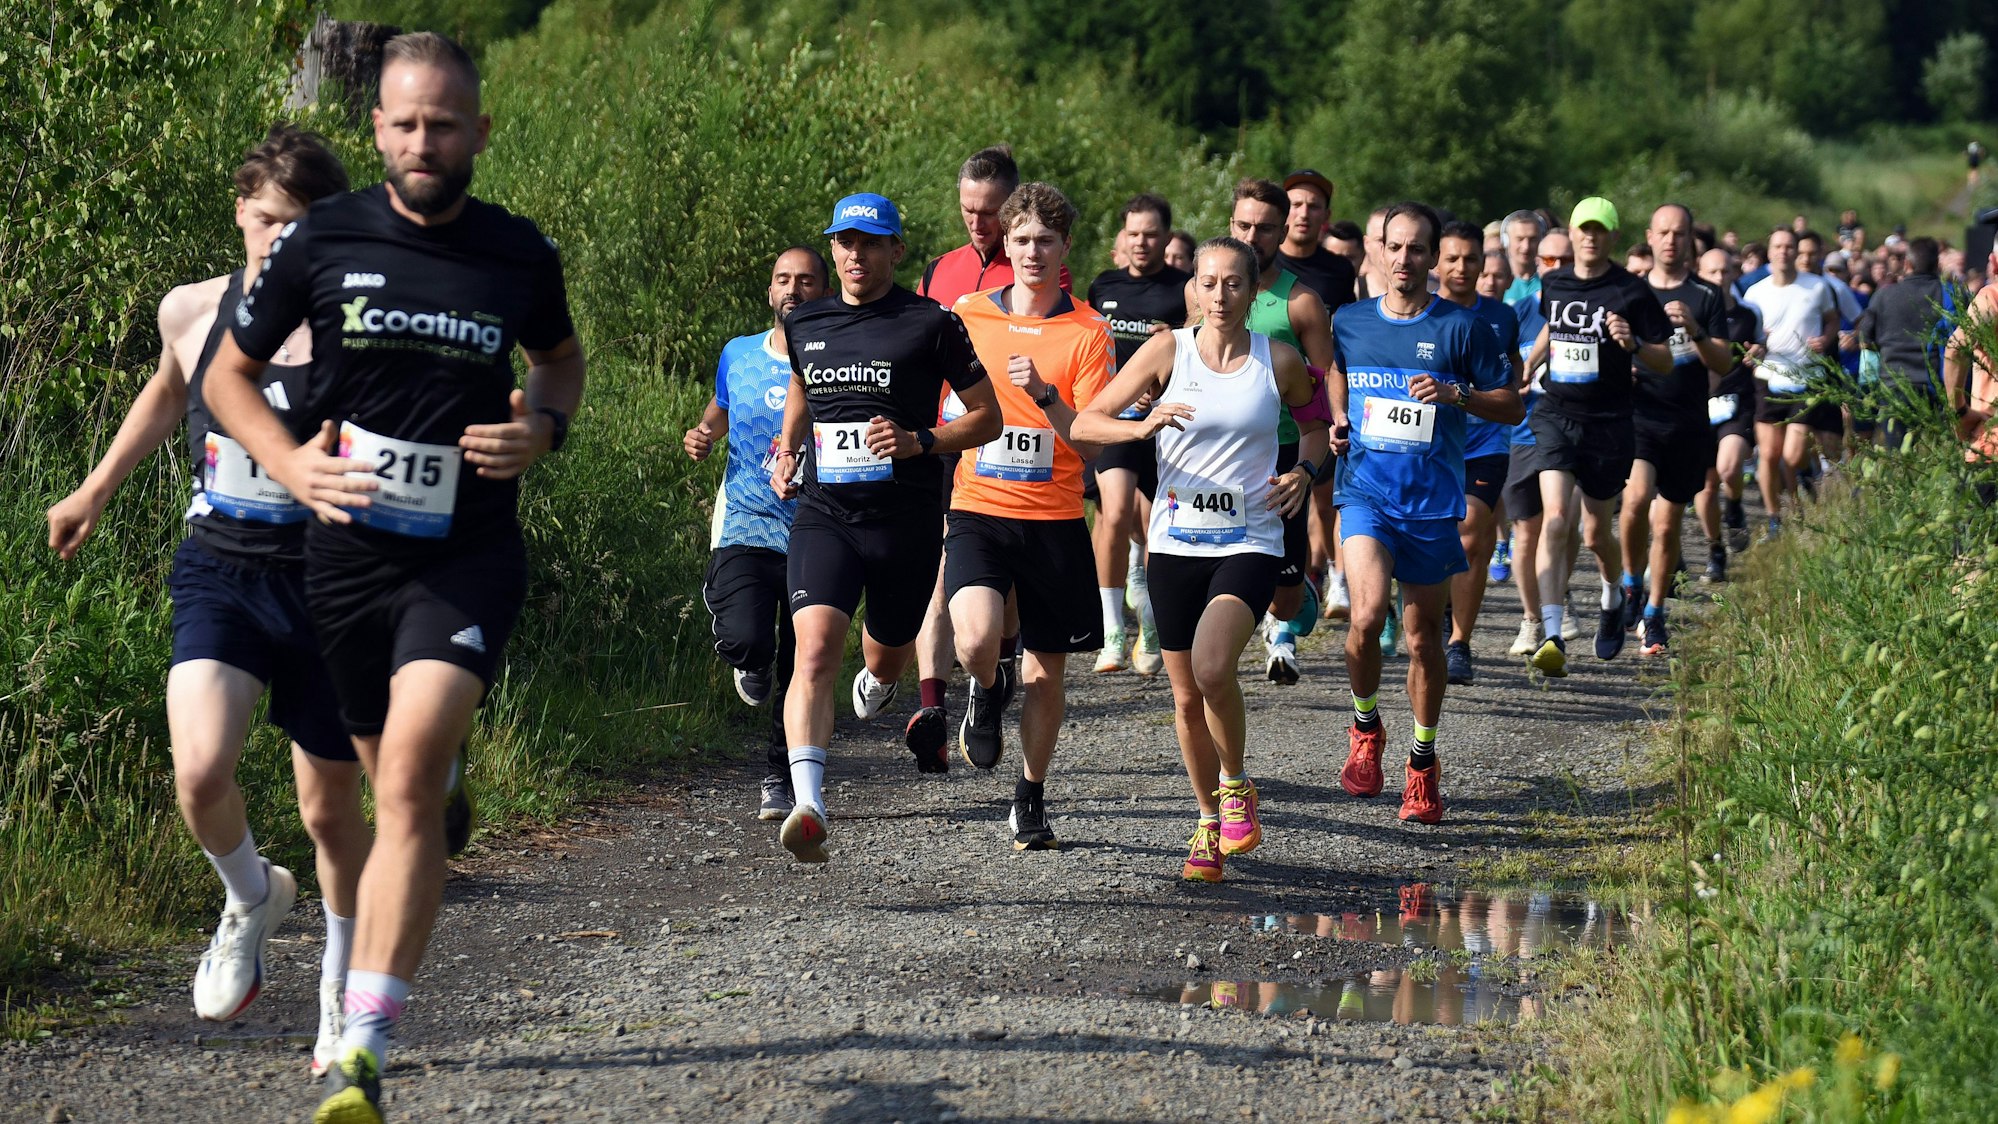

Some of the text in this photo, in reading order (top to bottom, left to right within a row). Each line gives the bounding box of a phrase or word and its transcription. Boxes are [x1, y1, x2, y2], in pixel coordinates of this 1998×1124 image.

[841, 205, 878, 220] HOKA
[341, 296, 502, 353] Xcoating
[1549, 300, 1587, 328] LG
[1008, 323, 1042, 336] hummel
[804, 341, 826, 352] JAKO
[1416, 342, 1435, 350] PFERD
[1564, 348, 1590, 361] 430
[803, 362, 891, 388] Xcoating
[1387, 406, 1422, 427] 461
[836, 429, 868, 450] 21
[1004, 431, 1042, 453] 161
[376, 448, 443, 487] 215
[846, 456, 871, 464] Moritz
[1011, 456, 1034, 465] Lasse
[1192, 492, 1234, 513] 440
